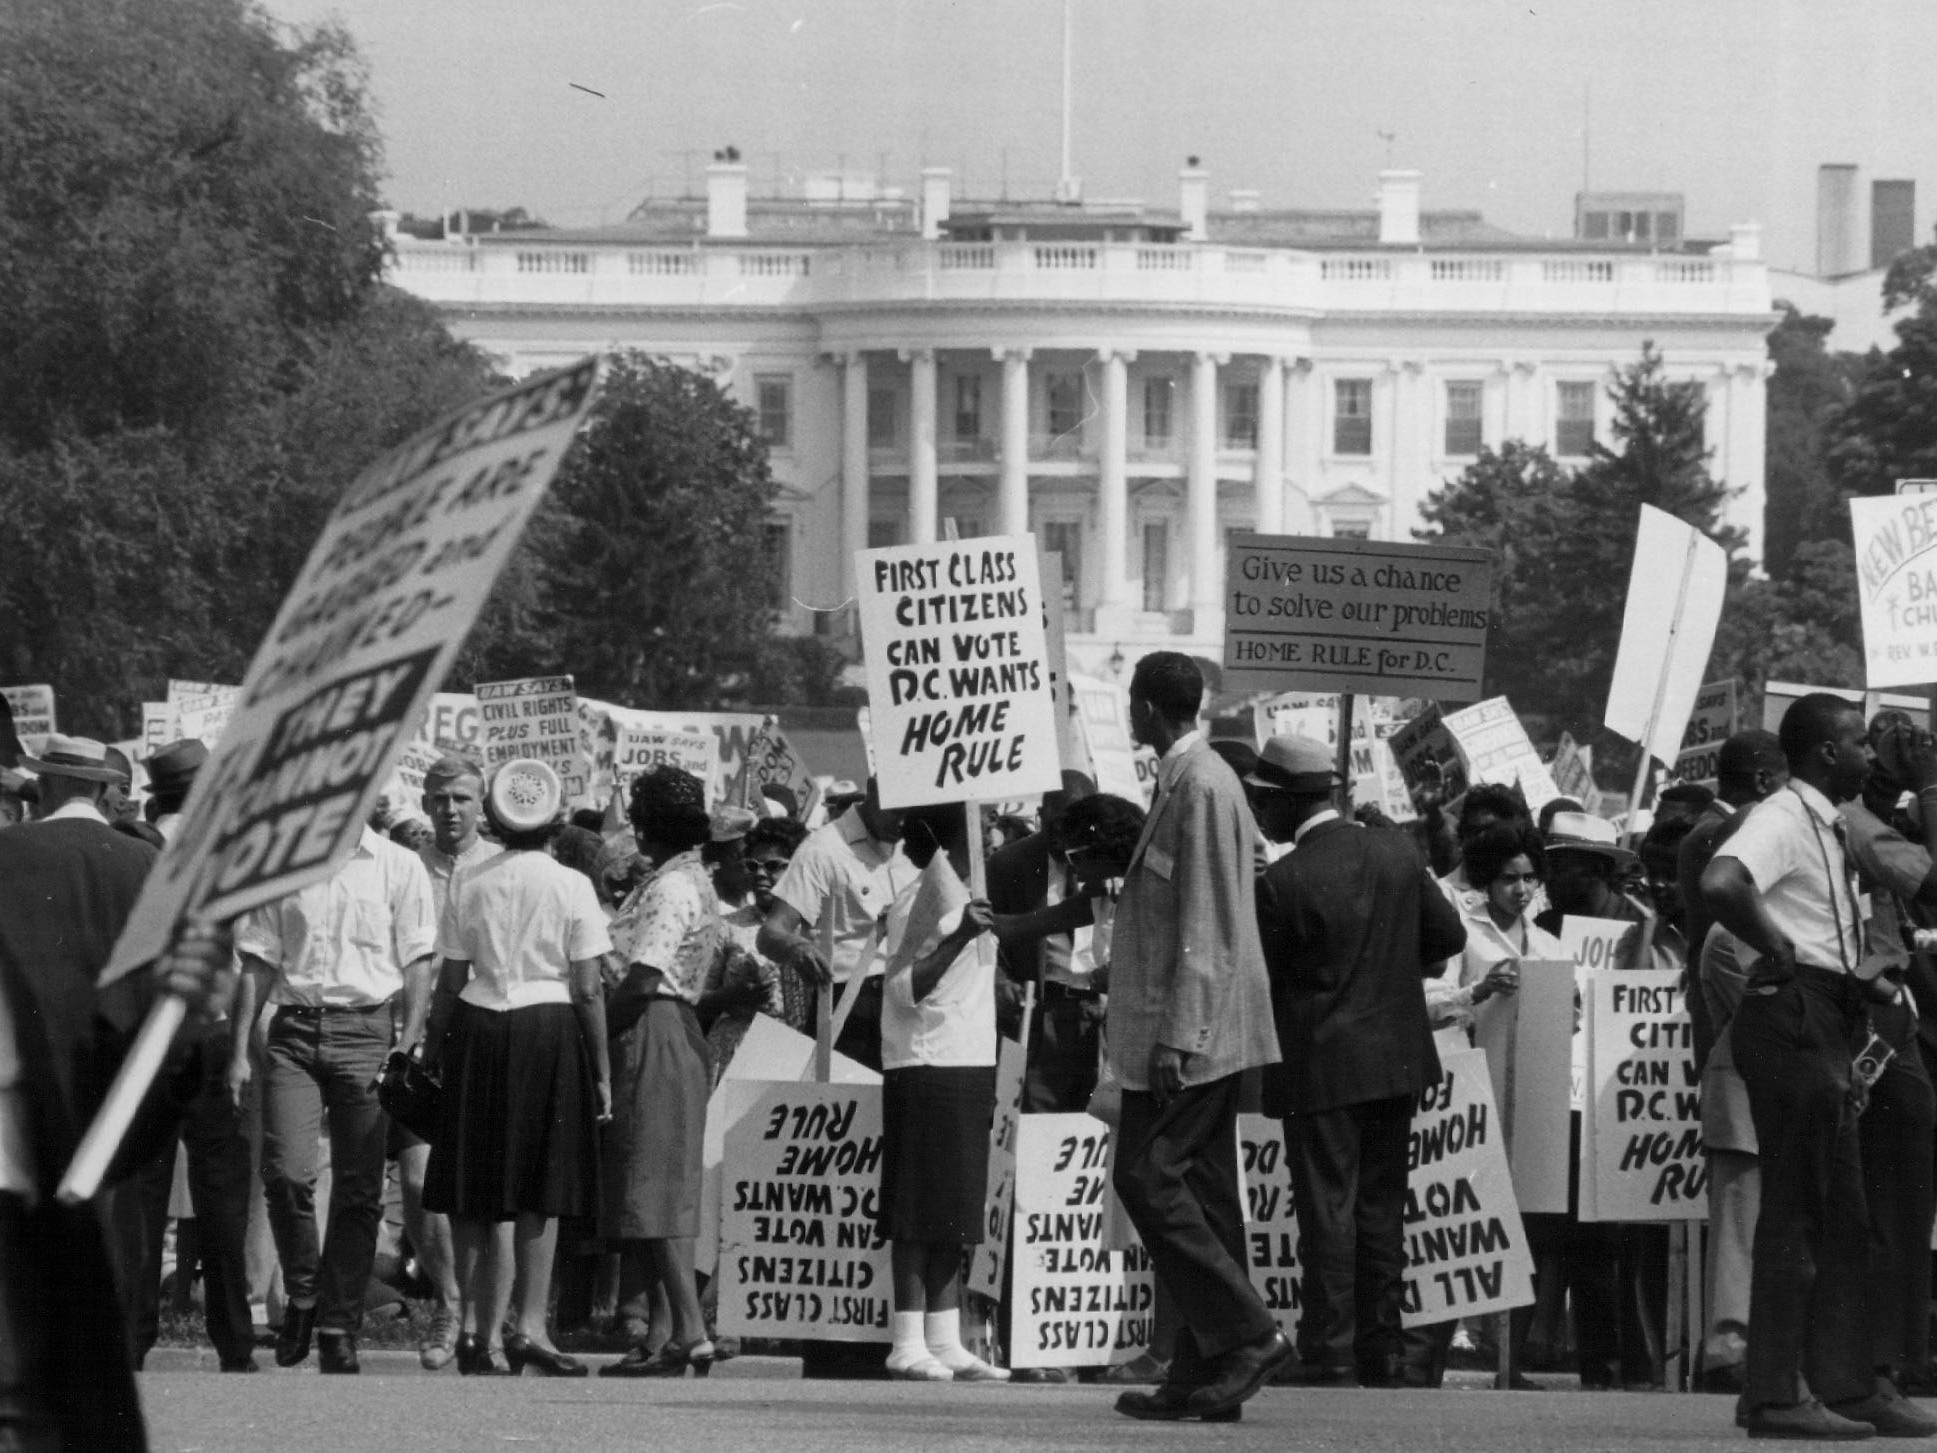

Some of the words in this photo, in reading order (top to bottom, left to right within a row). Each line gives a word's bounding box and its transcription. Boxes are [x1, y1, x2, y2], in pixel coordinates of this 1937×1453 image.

[875, 559, 940, 593] FIRST
[948, 551, 1016, 588] CLASS
[1241, 555, 1303, 583] Give
[1312, 564, 1346, 584] us
[1351, 567, 1368, 588] a
[1373, 564, 1462, 594] chance
[895, 587, 1028, 627] CITIZENS
[1233, 590, 1261, 616] to
[1267, 593, 1334, 620] solve
[1341, 602, 1388, 623] our
[1389, 602, 1487, 632] problems
[886, 637, 941, 667] CAN
[952, 630, 1022, 662] VOTE
[1235, 640, 1302, 662] HOME
[1311, 643, 1372, 668] RULE
[1376, 649, 1410, 673] for
[1414, 651, 1456, 673] D.C.
[889, 668, 948, 706] D.C.
[949, 659, 1041, 698] WANTS
[482, 702, 519, 721] CIVIL
[522, 696, 573, 717] RIGHTS
[486, 723, 529, 742] PLUS
[539, 717, 572, 736] FULL
[628, 734, 666, 744] UAW
[900, 700, 1011, 756] HOME
[486, 737, 576, 763] EMPLOYMENT
[622, 748, 682, 766] JOBS
[935, 734, 1026, 788] RULE
[1613, 985, 1677, 1013] FIRST
[1630, 1022, 1691, 1049] CITI
[1616, 1060, 1669, 1085] CAN
[764, 1100, 857, 1142] RULE
[1616, 1089, 1672, 1122] D.C.
[776, 1136, 884, 1177] HOME
[733, 1181, 833, 1215] WANTS
[754, 1216, 825, 1247] VOTE
[738, 1256, 873, 1290] CITIZENS
[1046, 1248, 1111, 1273] VOTE
[1031, 1284, 1152, 1315] CITIZENS
[1434, 1261, 1504, 1306] ALL
[746, 1291, 823, 1323] CLASS
[827, 1296, 888, 1328] FIRST
[1039, 1320, 1109, 1351] CLASS
